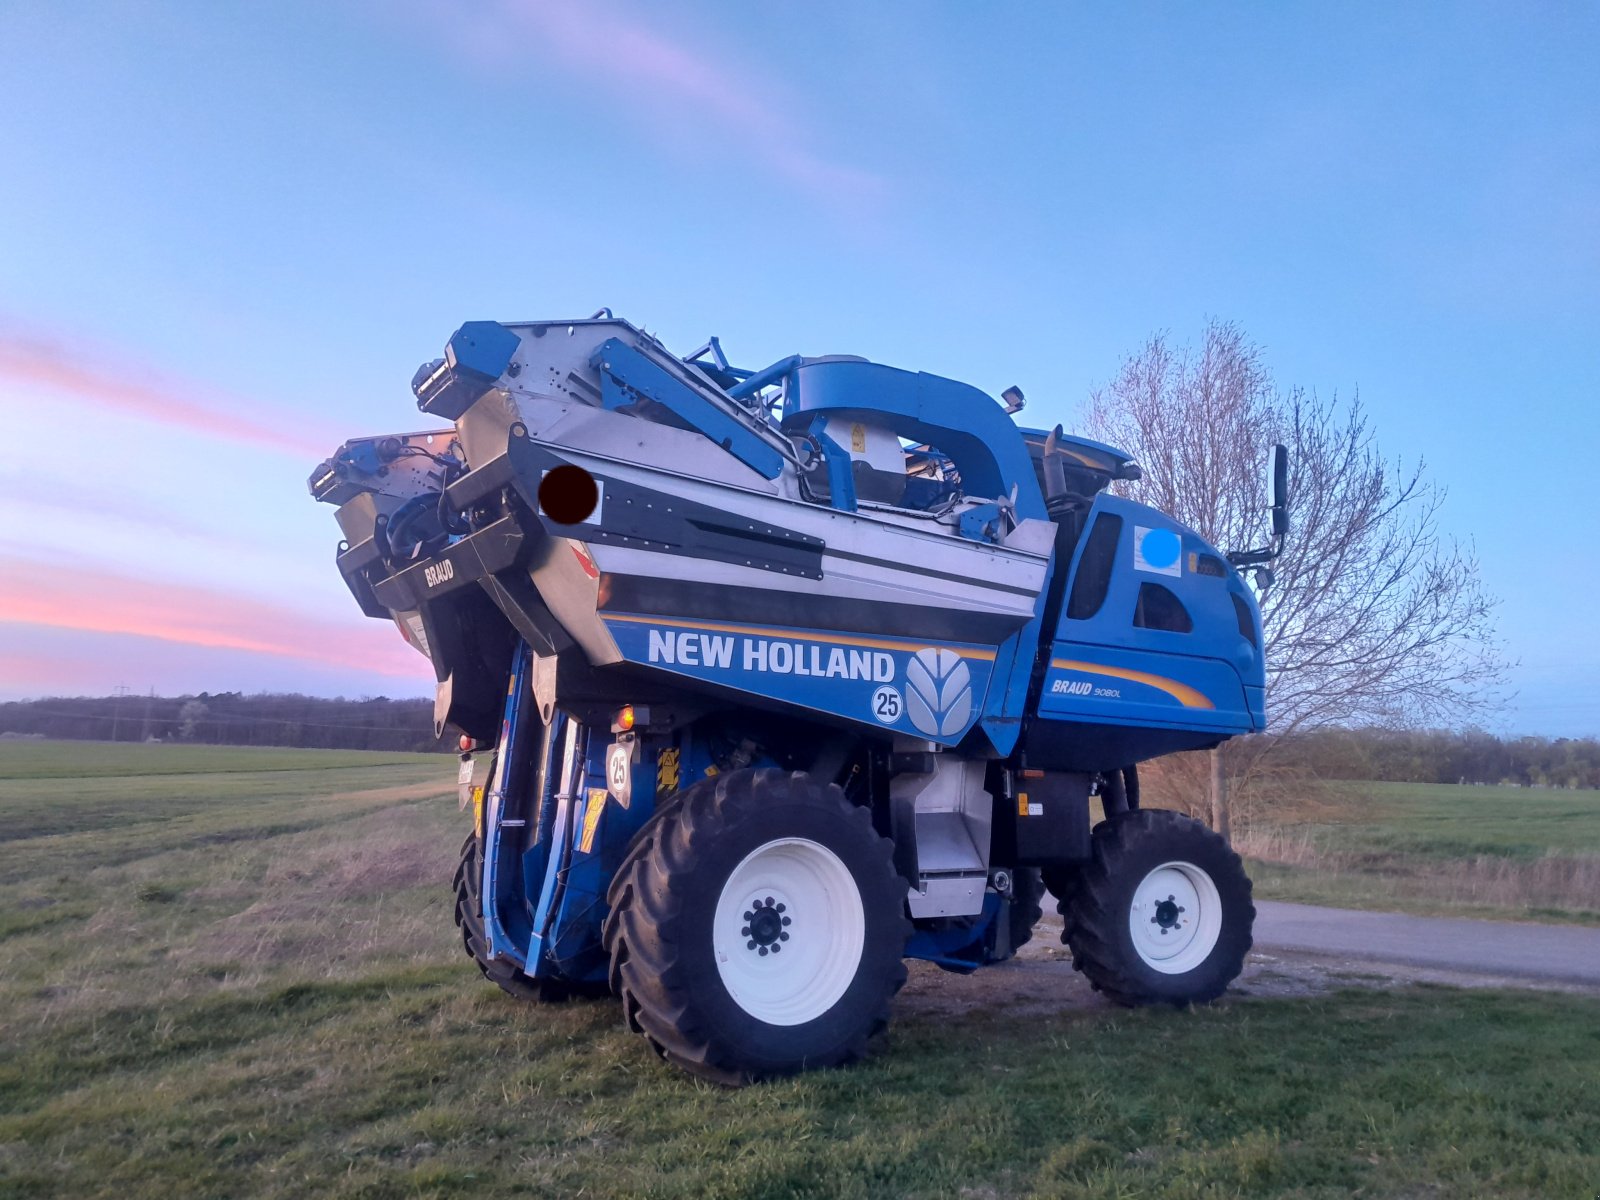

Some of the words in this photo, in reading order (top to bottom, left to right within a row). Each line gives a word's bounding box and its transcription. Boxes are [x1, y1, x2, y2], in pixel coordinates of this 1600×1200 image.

[424, 559, 454, 588] BRAUD
[649, 630, 735, 668] NEW
[743, 639, 895, 682] HOLLAND
[1051, 680, 1092, 695] BRAUD
[1094, 688, 1121, 698] 9080L
[877, 692, 899, 716] 25
[613, 756, 625, 785] 25
